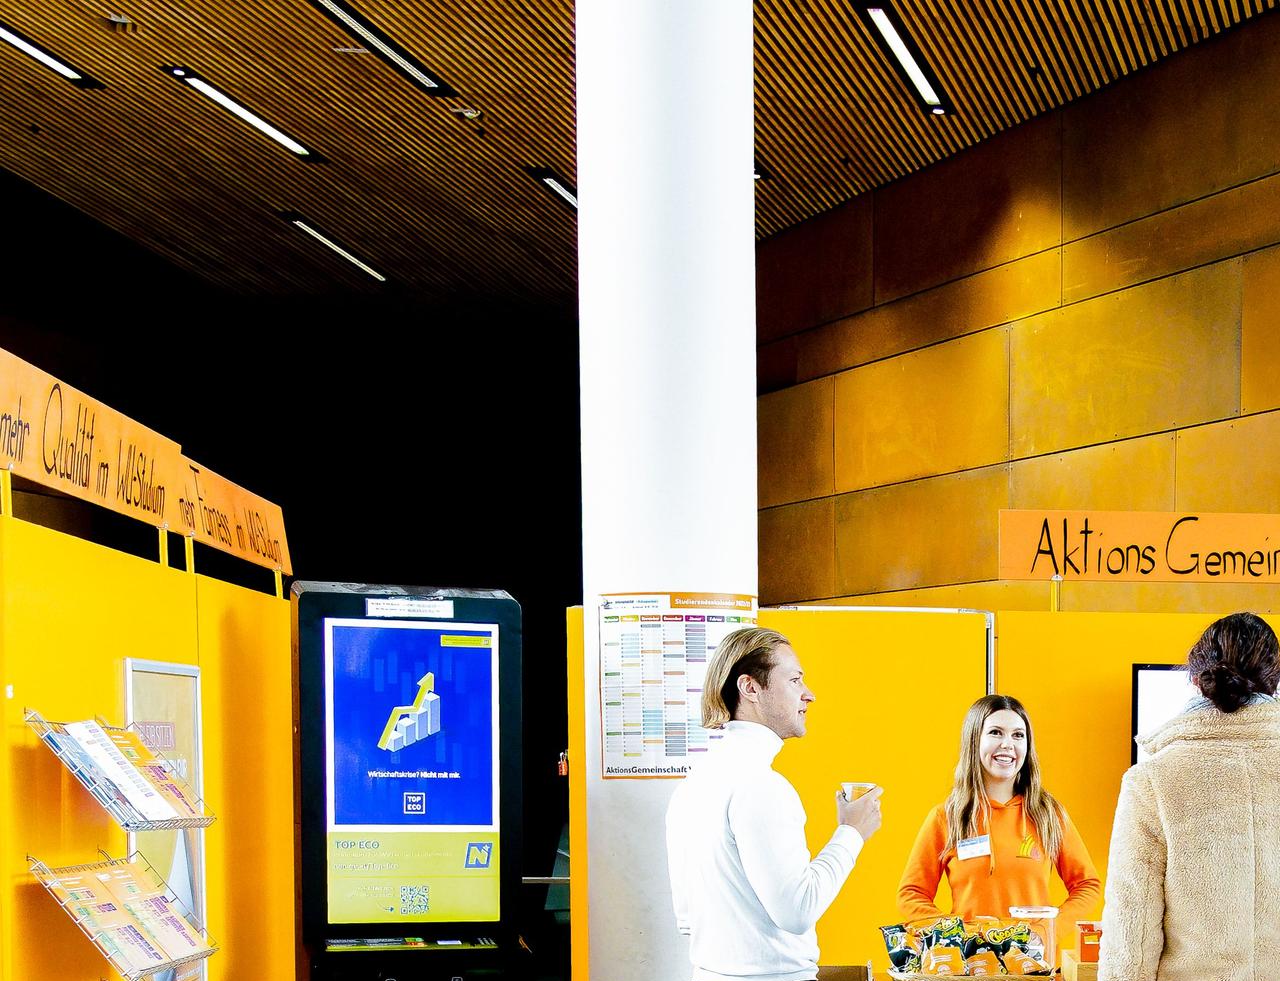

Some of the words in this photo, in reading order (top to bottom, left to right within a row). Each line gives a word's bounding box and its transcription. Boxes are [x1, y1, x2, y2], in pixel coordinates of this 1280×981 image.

[0, 395, 30, 464] mehr
[43, 383, 95, 489] Qualität
[96, 449, 109, 498] im
[606, 766, 688, 774] AktionsGemeinschaft
[335, 841, 356, 849] TOP
[359, 841, 379, 849] ECO
